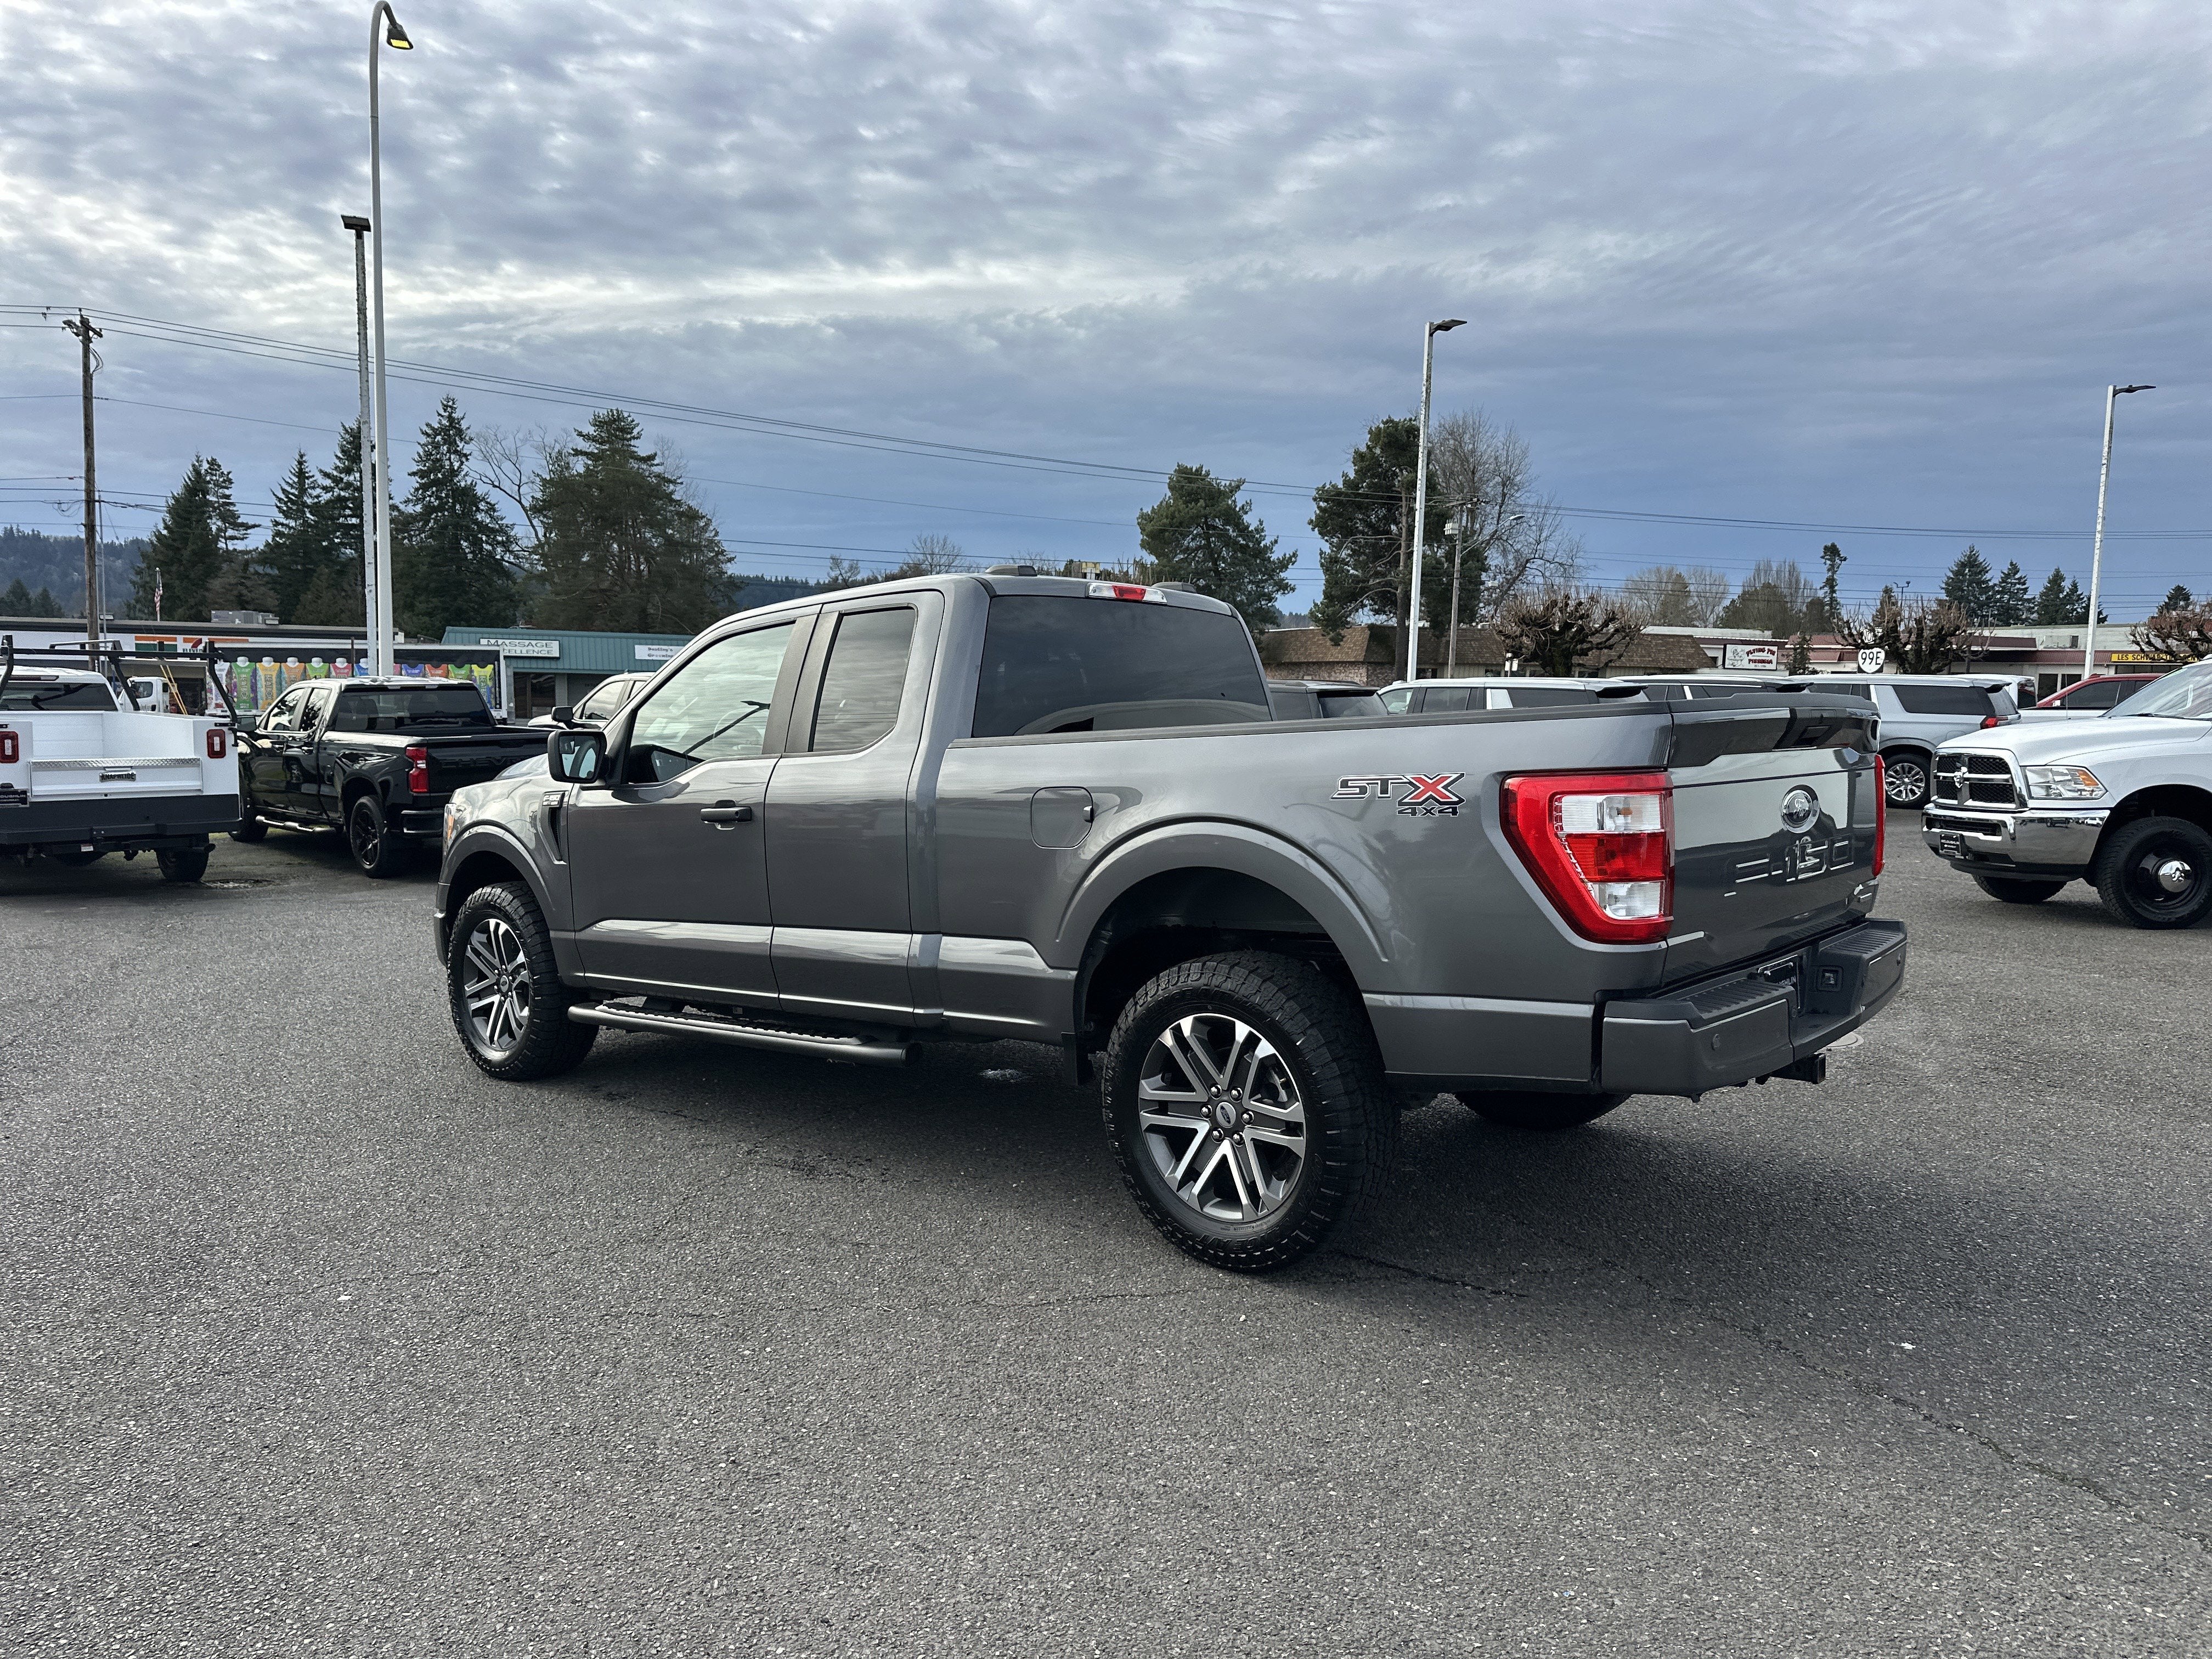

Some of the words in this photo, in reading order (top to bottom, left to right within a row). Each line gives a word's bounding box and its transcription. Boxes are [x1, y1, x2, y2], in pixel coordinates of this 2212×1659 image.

[487, 640, 554, 648] MASSAGE
[1861, 651, 1882, 665] 99E
[1330, 772, 1465, 806] STX
[1724, 835, 1854, 897] F-150
